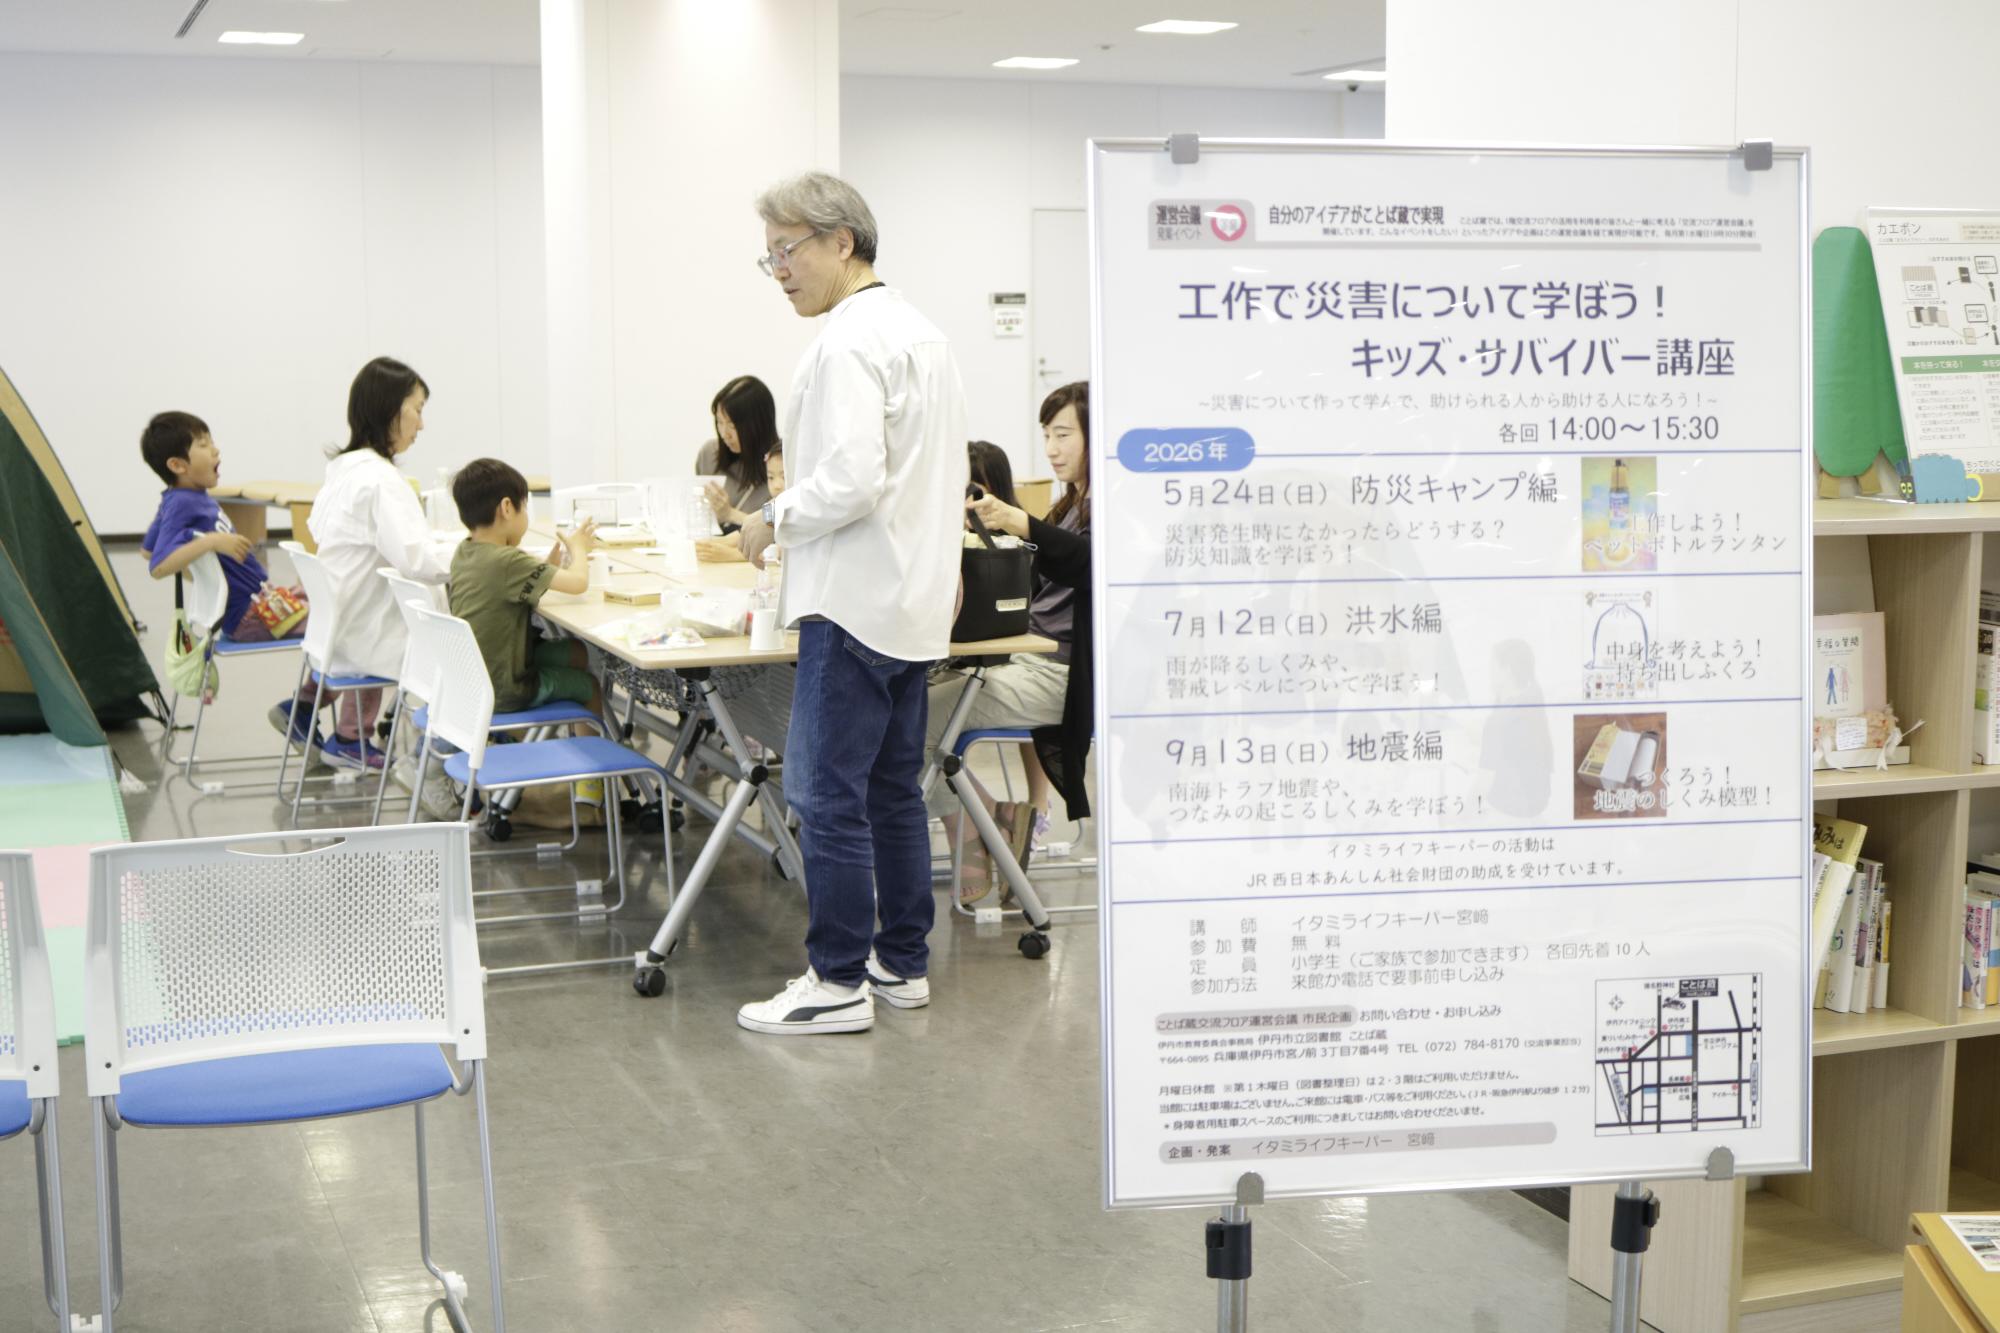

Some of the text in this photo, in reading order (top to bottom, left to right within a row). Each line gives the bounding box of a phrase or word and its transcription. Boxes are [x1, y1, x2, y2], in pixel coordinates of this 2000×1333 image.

[1269, 205, 1444, 225] 自分のアイデアがことば蔵で実現
[1178, 281, 1665, 321] 工作で災害について学ぼう！
[1351, 338, 1736, 378] キッズ・サバイバー講座
[1498, 423, 1539, 444] 各回
[1351, 472, 1558, 505] 防災キャンプ編
[1164, 518, 1506, 545] 災害発生時になかったらどうする？
[1164, 543, 1353, 568] 防災知識を学ぼう！
[1345, 602, 1442, 635] 洪水編
[1606, 638, 1762, 662] 中身を考えよう！
[1165, 652, 1349, 677] 雨が降るしくみや、
[1615, 659, 1757, 683] 持ち出しふくろ
[1165, 671, 1440, 699] 警戒レベルについて学ぼう！
[1345, 729, 1443, 763] 地震編
[1636, 765, 1732, 788] つくろう！
[1167, 776, 1352, 803] 南海トラフ地震や、
[1593, 785, 1774, 811] 地震のしくみ模型！
[1167, 795, 1484, 825] つなみの起こるしくみを学ぼう！
[1327, 836, 1555, 859] イタミライフキーパーの活動は
[1189, 965, 1506, 996] 参加方法 来館か電話で要事前申し込み
[1156, 1013, 1298, 1031] ことば蔵交流フロア運営会議
[1302, 1010, 1353, 1025] 市民企画
[1257, 1031, 1342, 1047] 伊丹市立図書館
[1348, 1028, 1388, 1042] ことば蔵
[1158, 1084, 1216, 1097] 月曜日休館
[1167, 1144, 1232, 1160] 企画・発案
